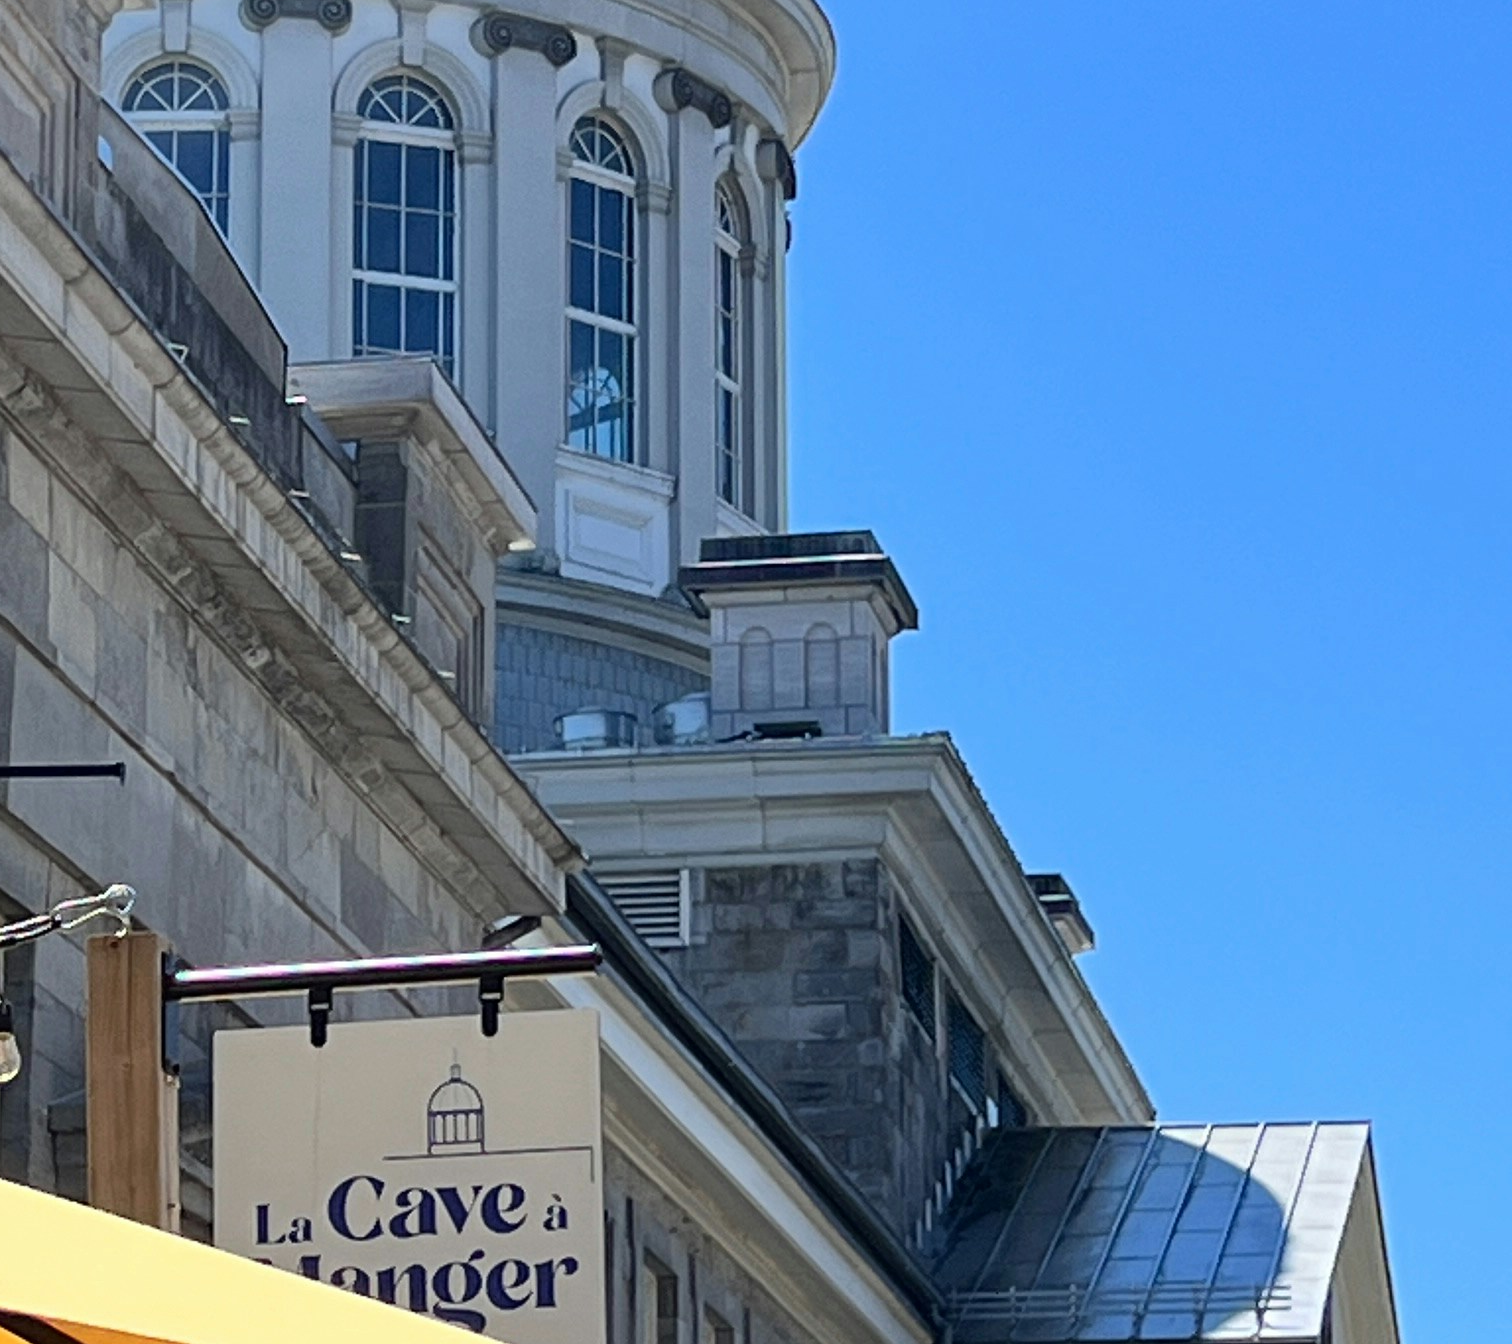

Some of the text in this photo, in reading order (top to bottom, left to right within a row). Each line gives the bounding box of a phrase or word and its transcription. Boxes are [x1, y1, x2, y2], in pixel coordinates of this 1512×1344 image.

[255, 1174, 569, 1245] La Cave à
[250, 1248, 579, 1334] anger
